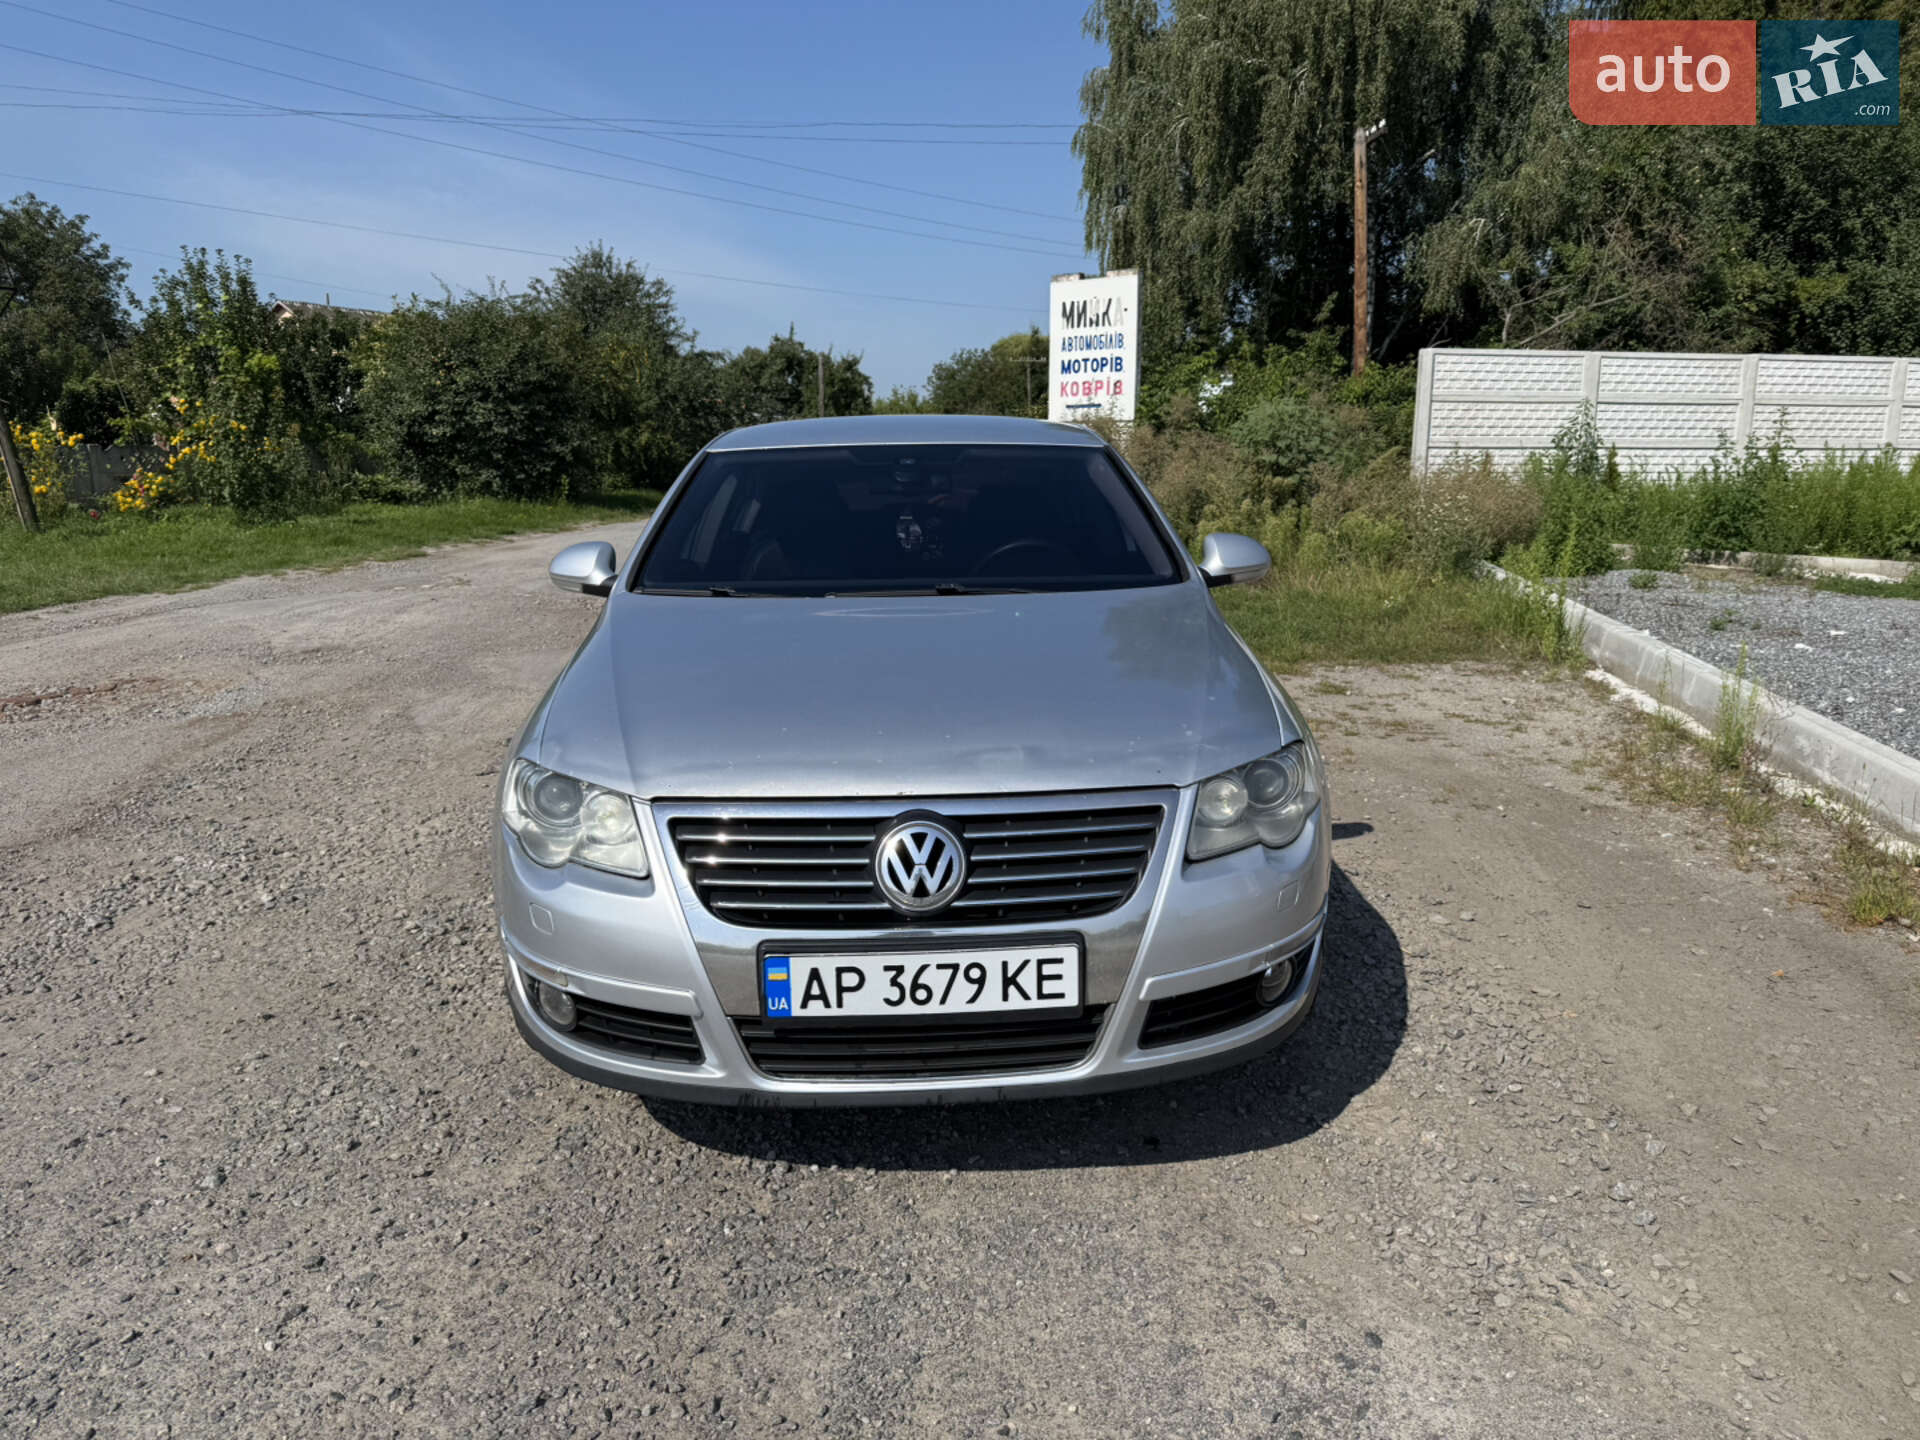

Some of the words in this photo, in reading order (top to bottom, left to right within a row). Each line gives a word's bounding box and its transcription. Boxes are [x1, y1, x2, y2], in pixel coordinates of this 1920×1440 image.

[1060, 354, 1124, 375] МОТОРІВ
[1060, 377, 1123, 398] КОВРІВ
[800, 966, 866, 1010] AP
[882, 962, 987, 1006] 3679
[1001, 957, 1066, 1002] KE
[768, 996, 789, 1010] UA
